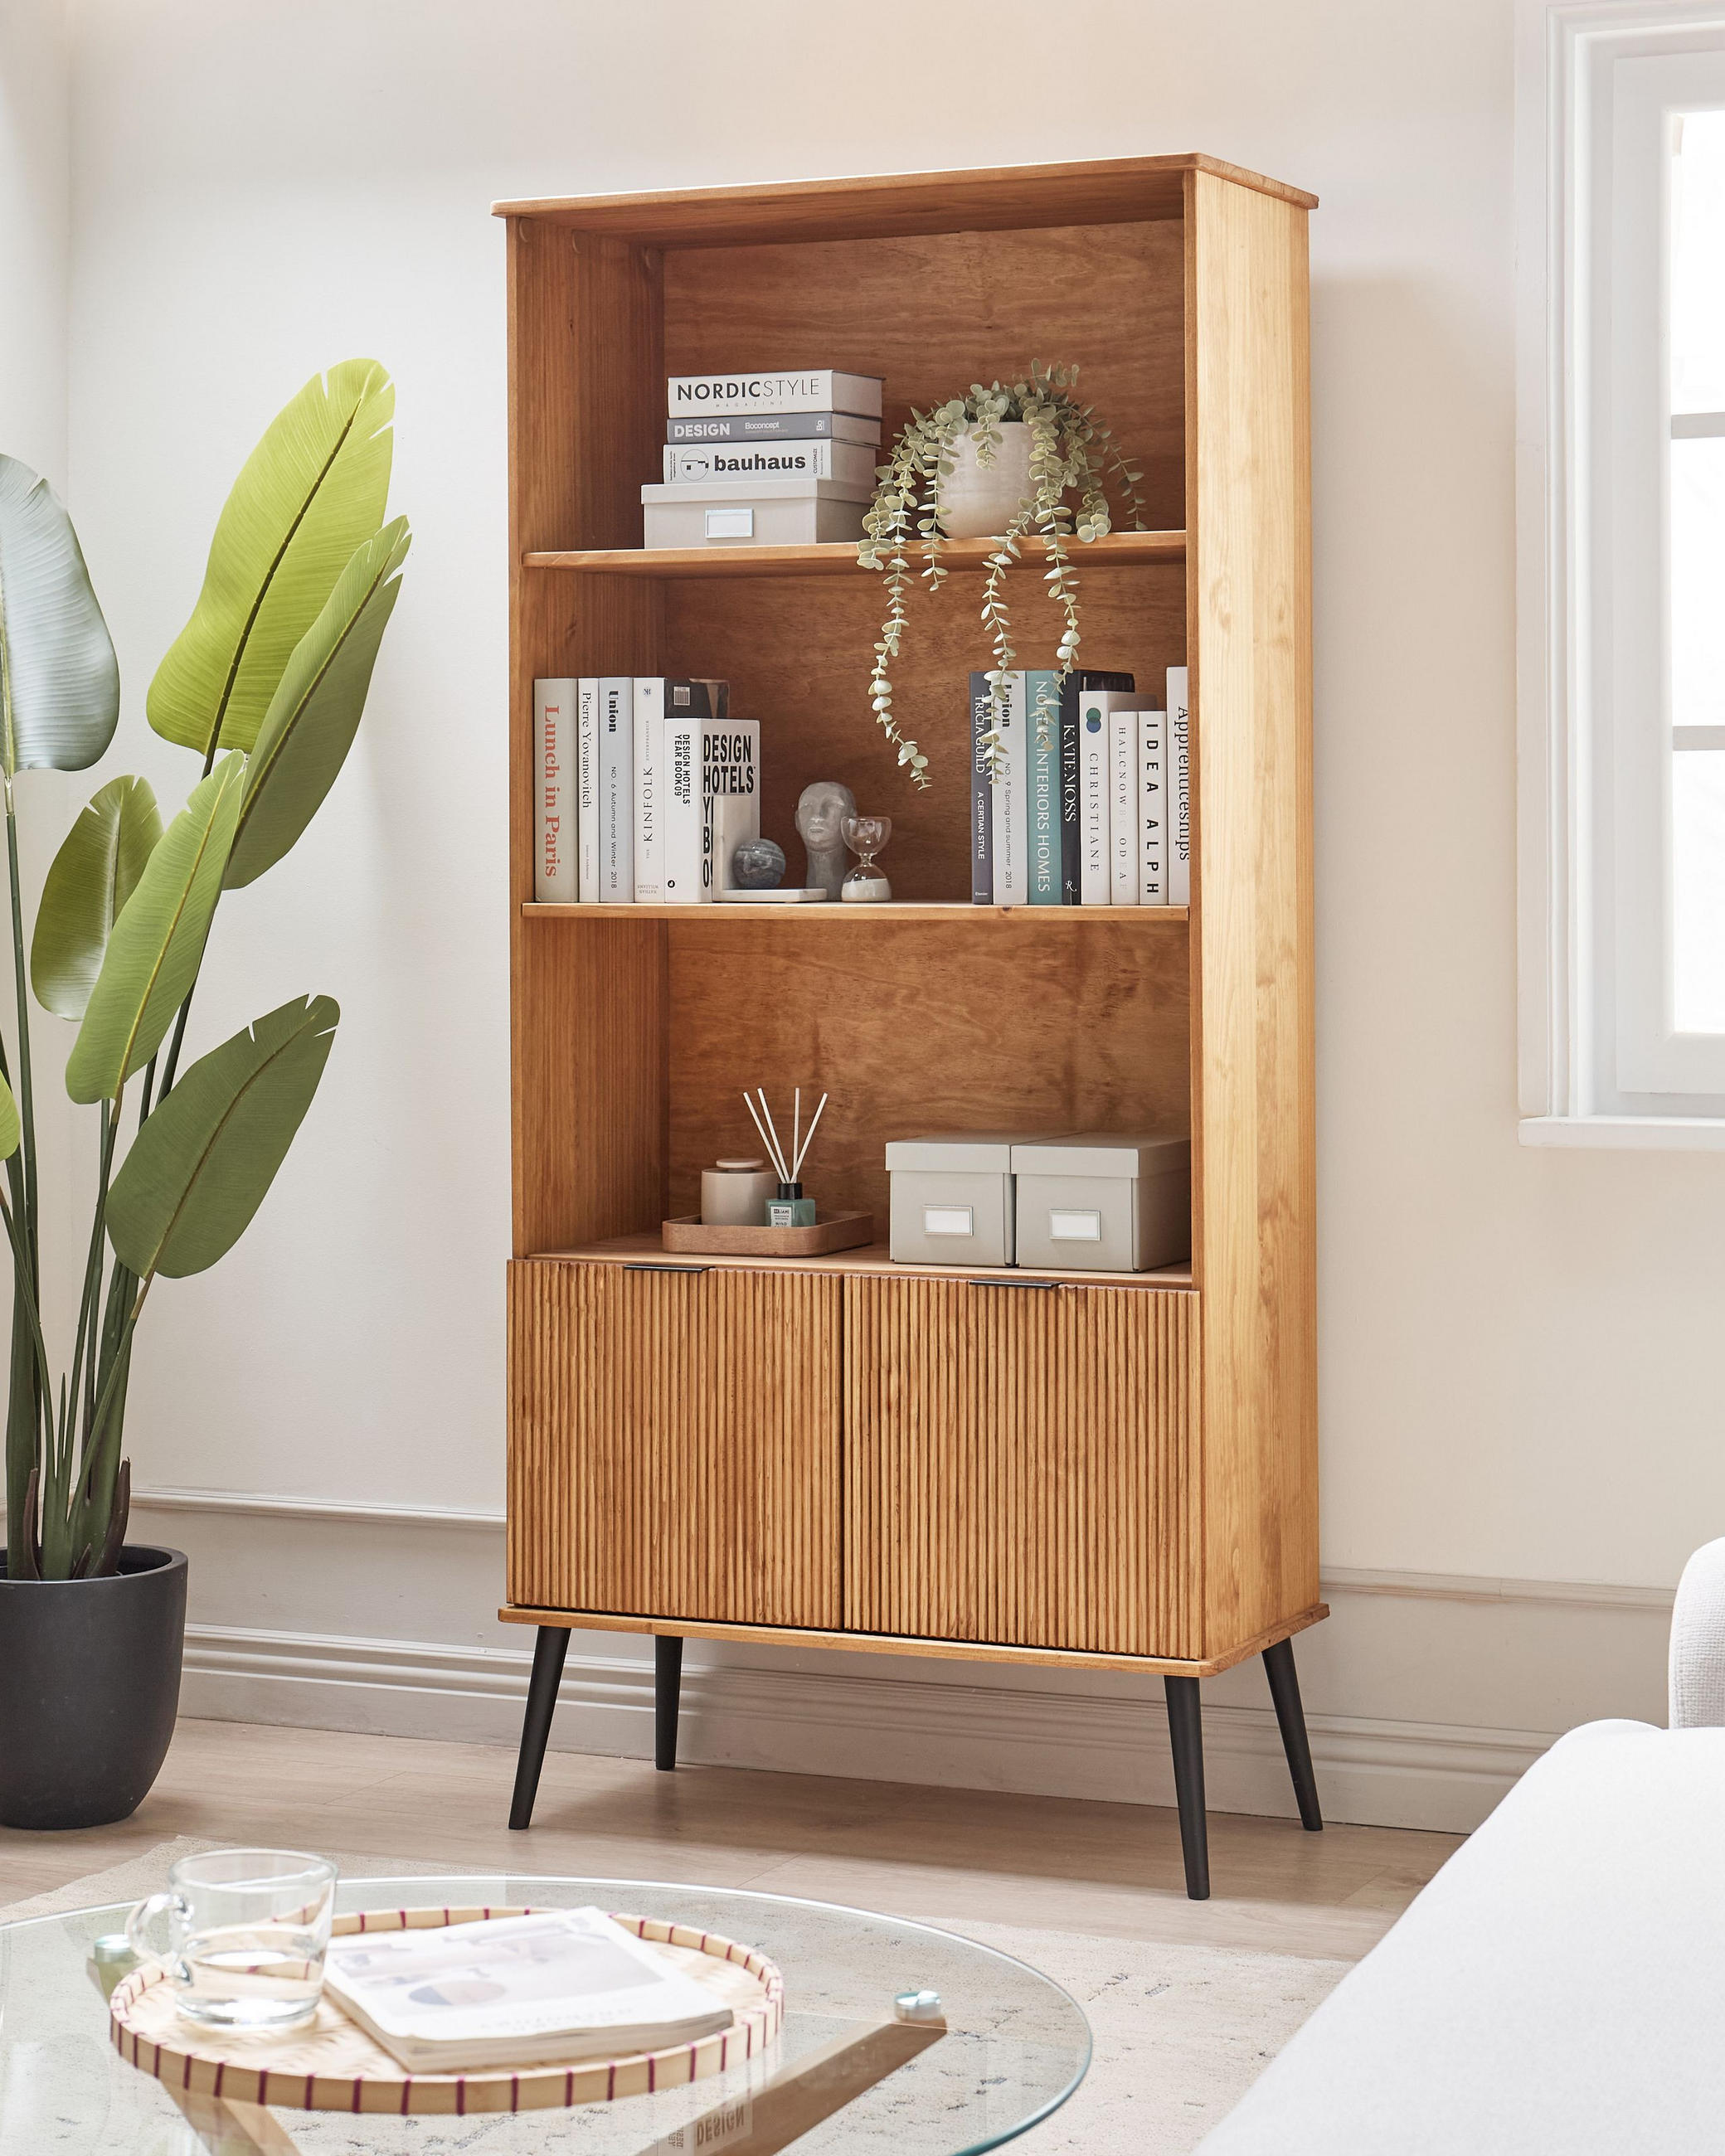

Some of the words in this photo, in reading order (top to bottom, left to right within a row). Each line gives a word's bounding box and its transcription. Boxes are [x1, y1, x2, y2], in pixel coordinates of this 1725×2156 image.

[674, 422, 731, 438] DESIGN
[714, 453, 806, 472] bauhaus
[582, 692, 592, 728] Pierre
[608, 690, 619, 732] Union
[974, 694, 984, 735] TRICIA
[544, 705, 561, 779] Lunch
[682, 734, 691, 767] DESIGN
[703, 735, 751, 763] DESIGN
[974, 736, 986, 775] GUILD
[1063, 724, 1076, 771] KATE
[1146, 723, 1159, 793] IDEA
[582, 731, 592, 808] Yovanovitch
[674, 760, 683, 786] BOOK
[683, 770, 691, 804] HOTELS
[703, 765, 755, 794] HOTELS
[1036, 749, 1050, 830] INTERIORS
[545, 785, 561, 808] in
[643, 766, 653, 842] KINFOLK
[674, 787, 683, 796] 09
[1003, 789, 1013, 818] Spring
[1064, 773, 1076, 822] MOSS
[1089, 753, 1100, 871] CHRISTIANE
[545, 814, 561, 877] Paris
[978, 835, 986, 860] STYLE
[1037, 834, 1052, 892] HOMES
[1146, 818, 1159, 893] ALPH
